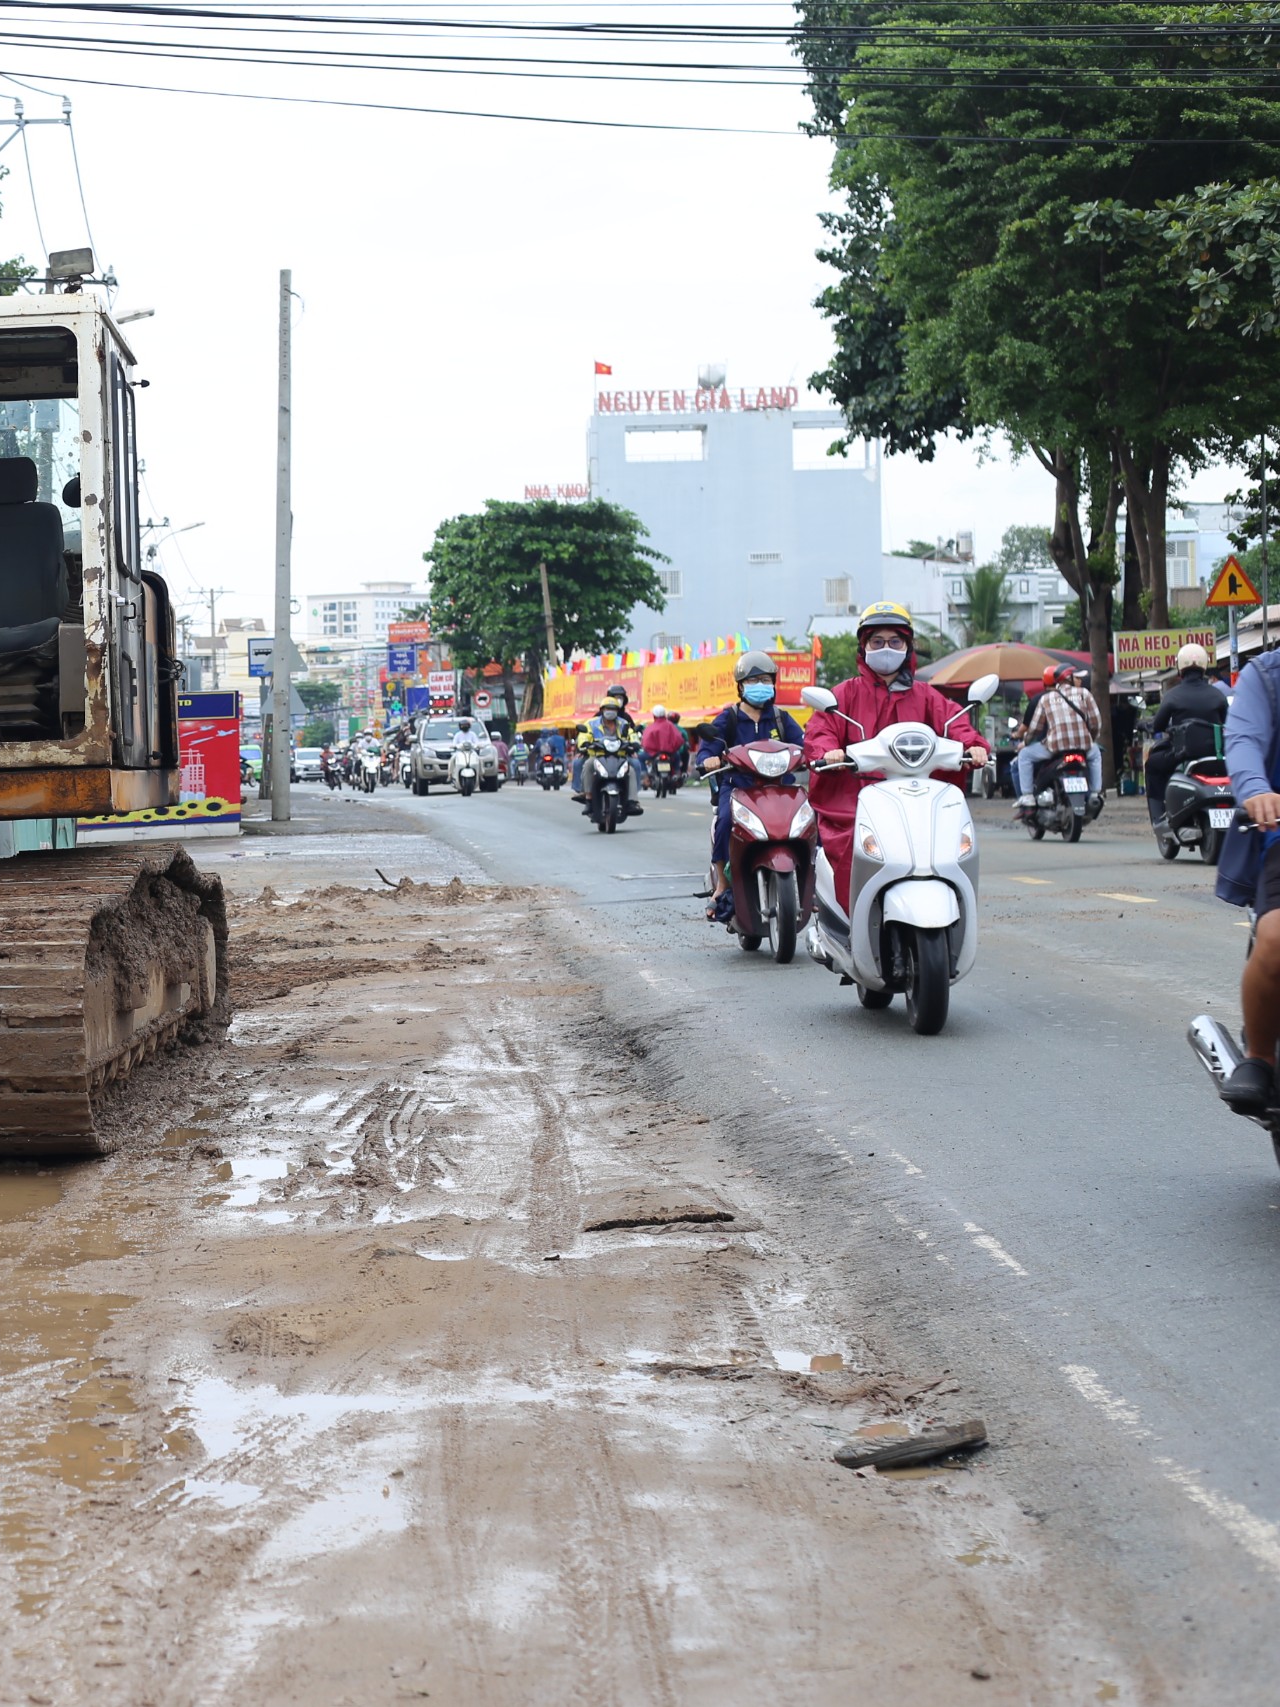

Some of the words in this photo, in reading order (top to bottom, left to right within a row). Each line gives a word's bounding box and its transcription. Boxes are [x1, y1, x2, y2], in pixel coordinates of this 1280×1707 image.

[598, 390, 686, 412] NGUYEN
[695, 387, 732, 410] GIA
[740, 386, 799, 409] LAND
